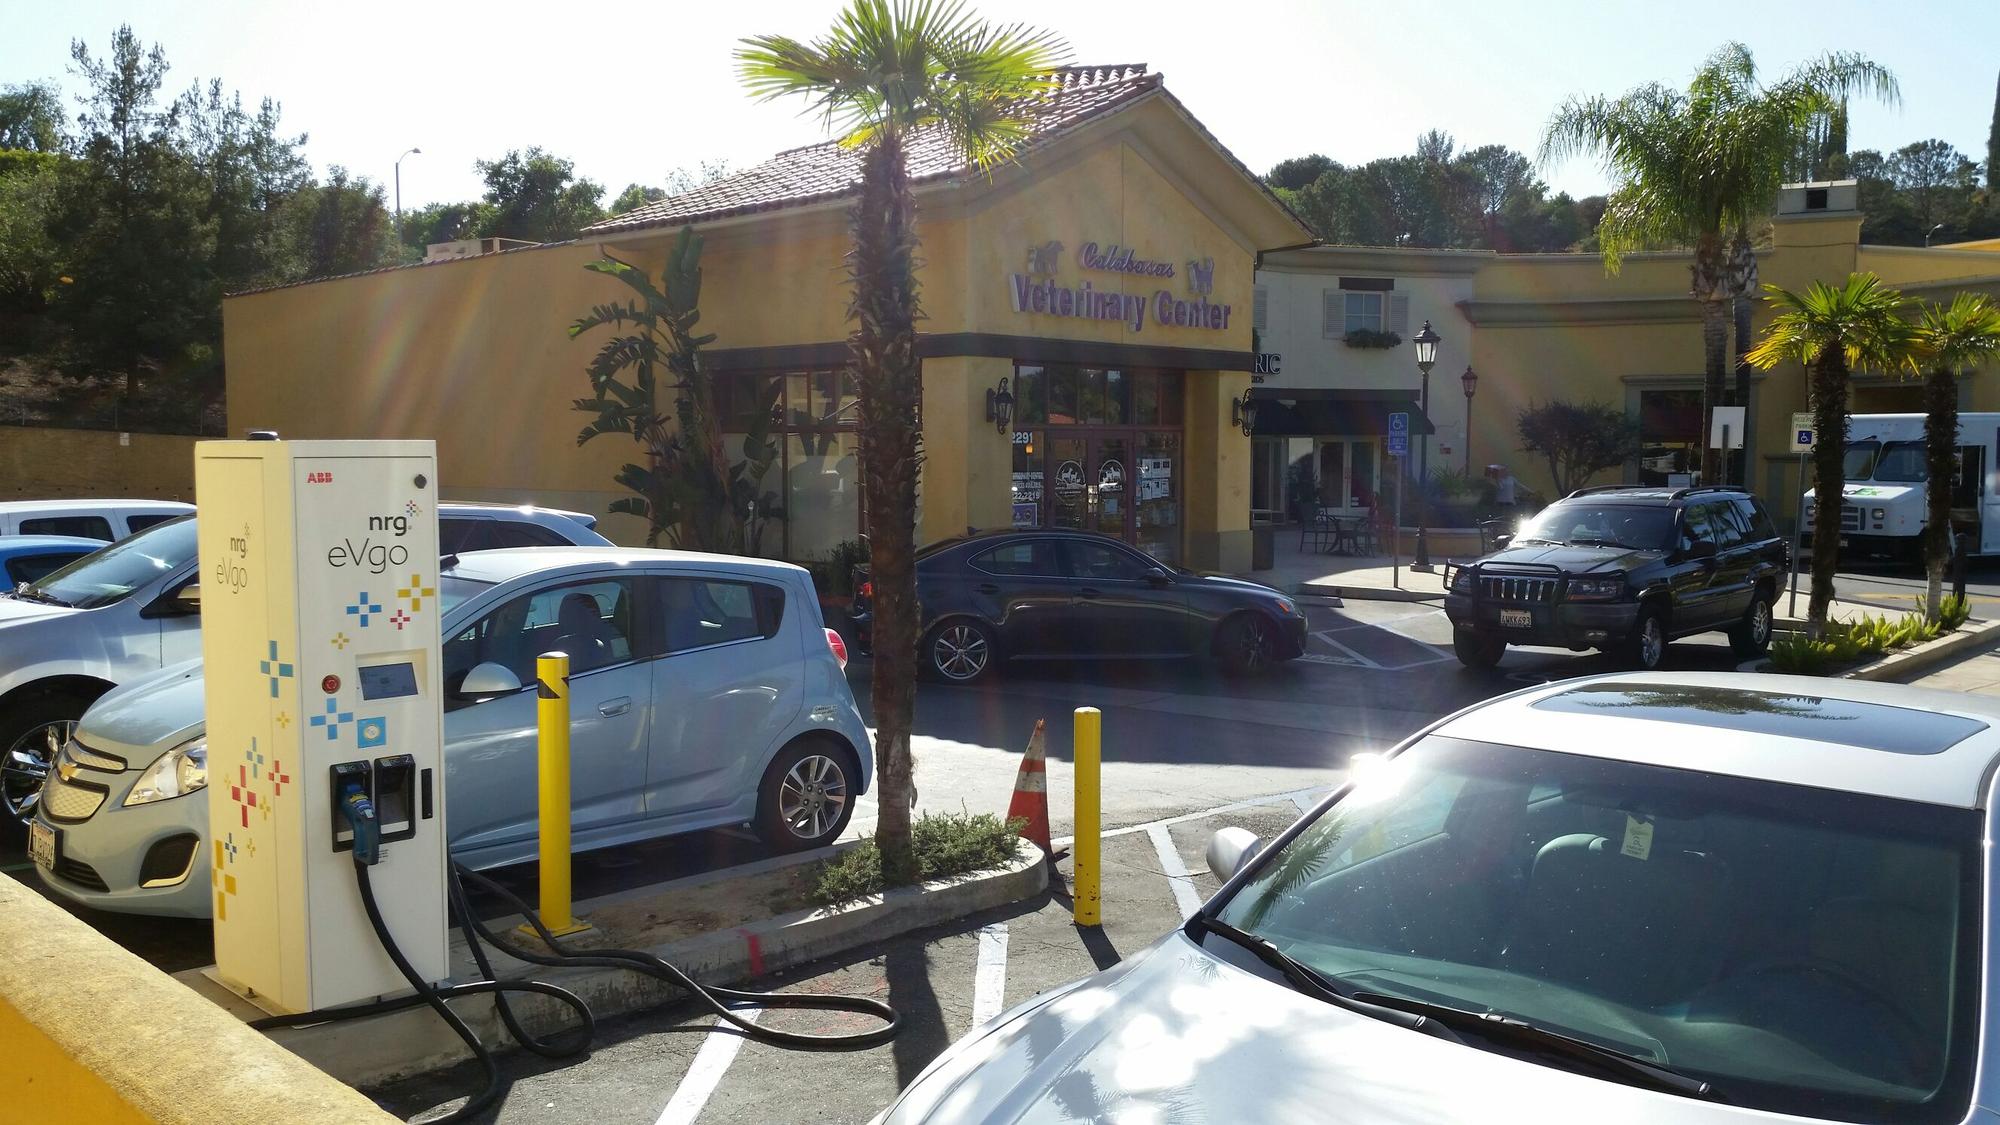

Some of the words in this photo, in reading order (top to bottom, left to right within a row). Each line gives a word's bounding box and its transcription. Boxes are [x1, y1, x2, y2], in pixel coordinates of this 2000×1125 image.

[1079, 241, 1175, 278] Calabasas
[1009, 271, 1146, 333] Veterinary
[1153, 290, 1231, 330] Center
[307, 472, 333, 484] ABB
[369, 515, 407, 536] nrg
[230, 536, 246, 559] nrg
[328, 537, 408, 574] eVgo
[216, 557, 248, 595] eVgo
